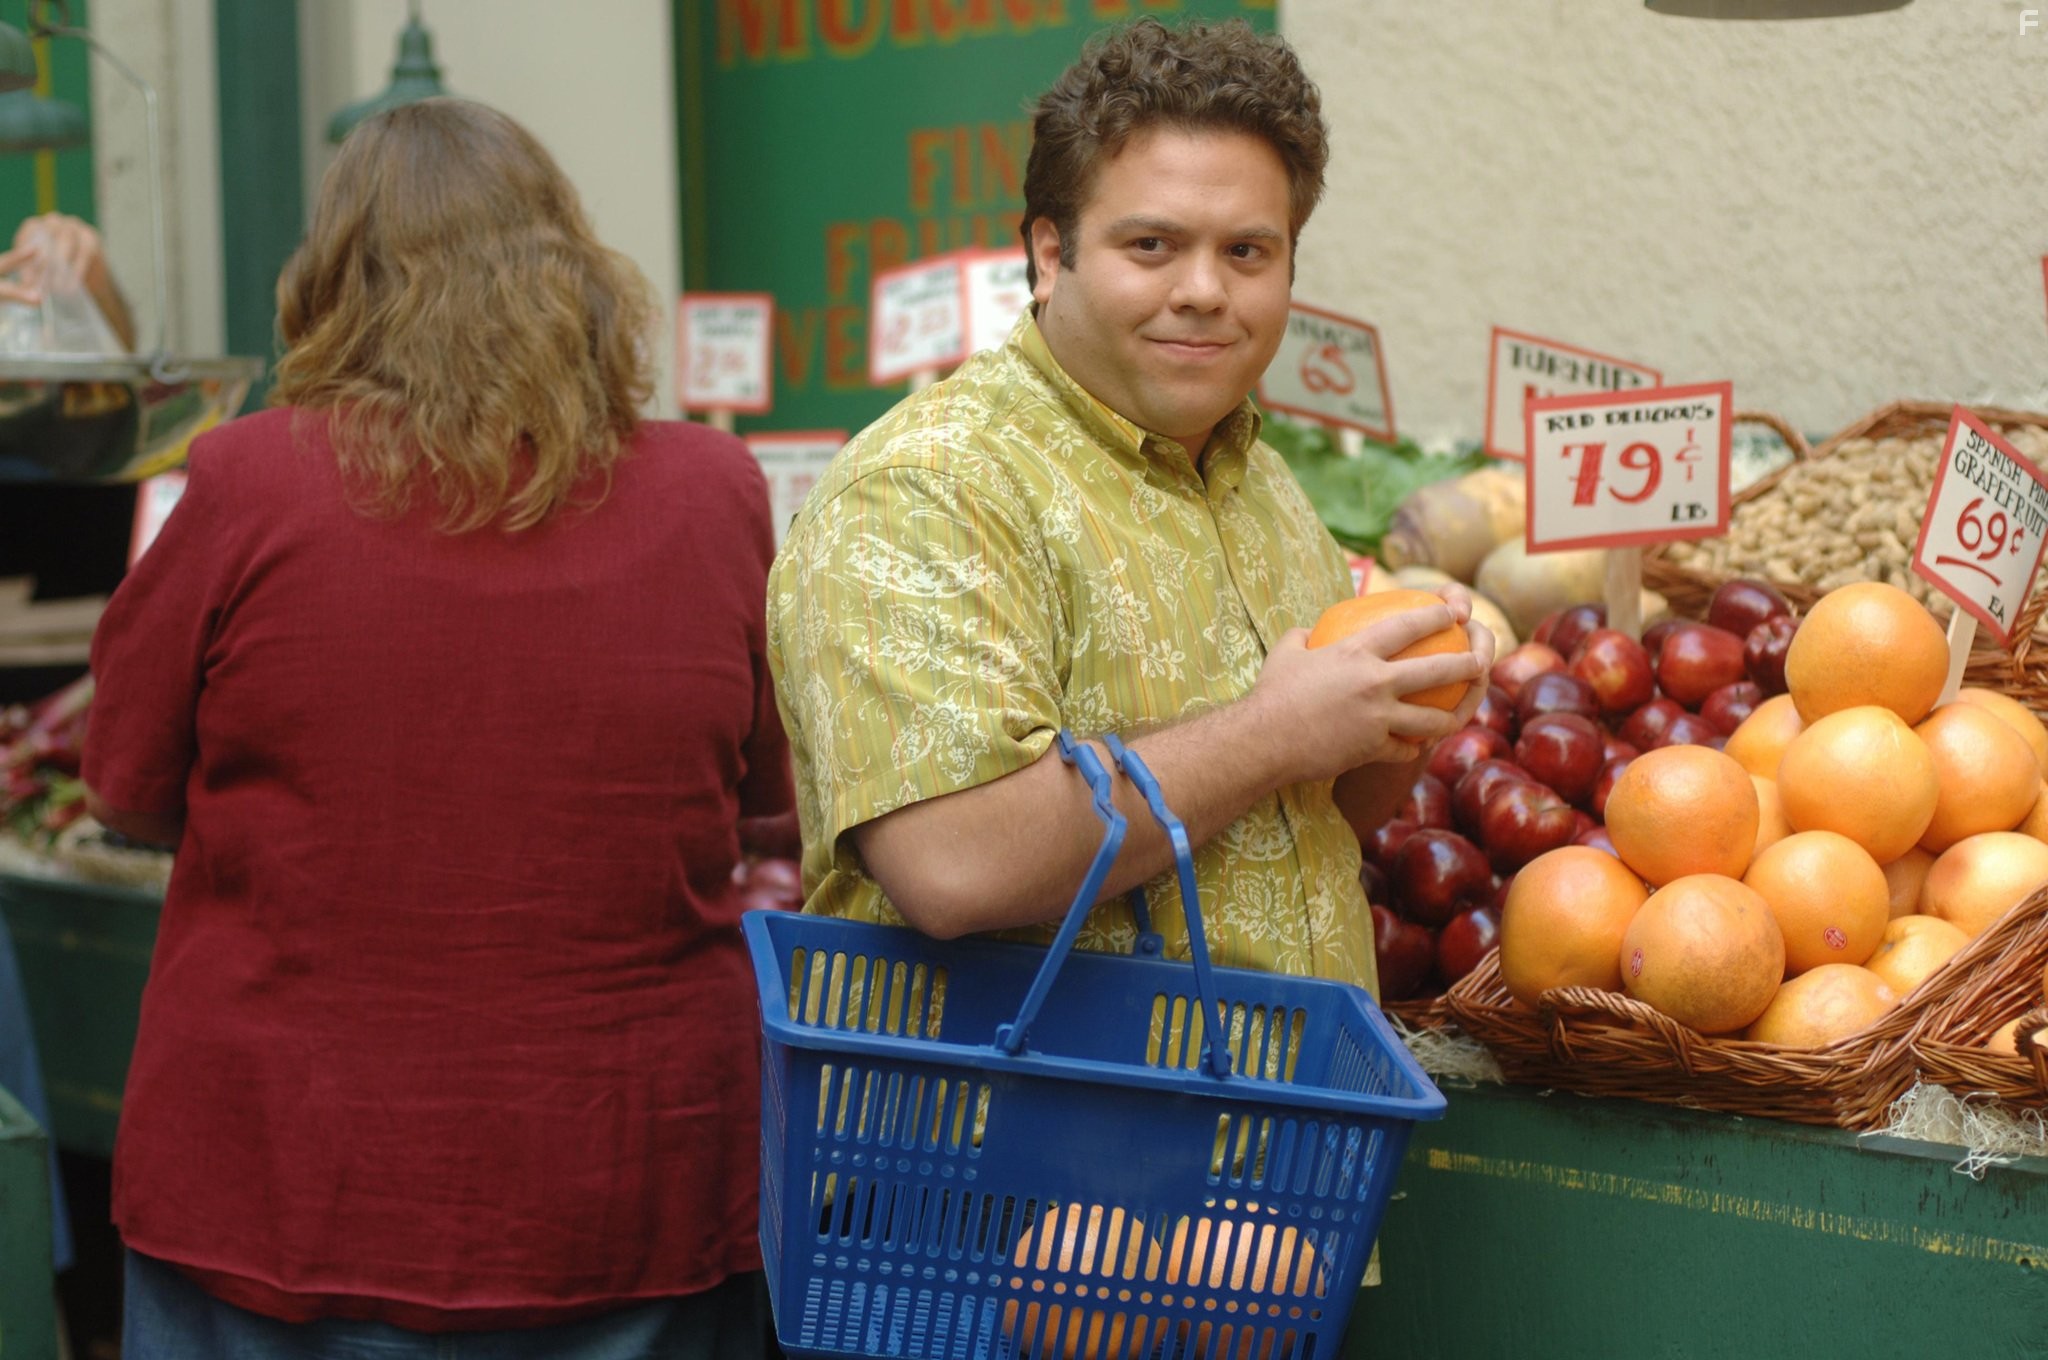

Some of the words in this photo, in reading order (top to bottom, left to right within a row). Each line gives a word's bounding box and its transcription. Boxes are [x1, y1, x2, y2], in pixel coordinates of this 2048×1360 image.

[909, 124, 1029, 209] FIN
[777, 306, 884, 390] VE
[1546, 413, 1595, 433] RED
[1966, 429, 2024, 485] SPANISH
[1671, 504, 1707, 522] LB
[1954, 449, 2048, 537] GRAPEFRUIT
[1988, 595, 2005, 624] EA
